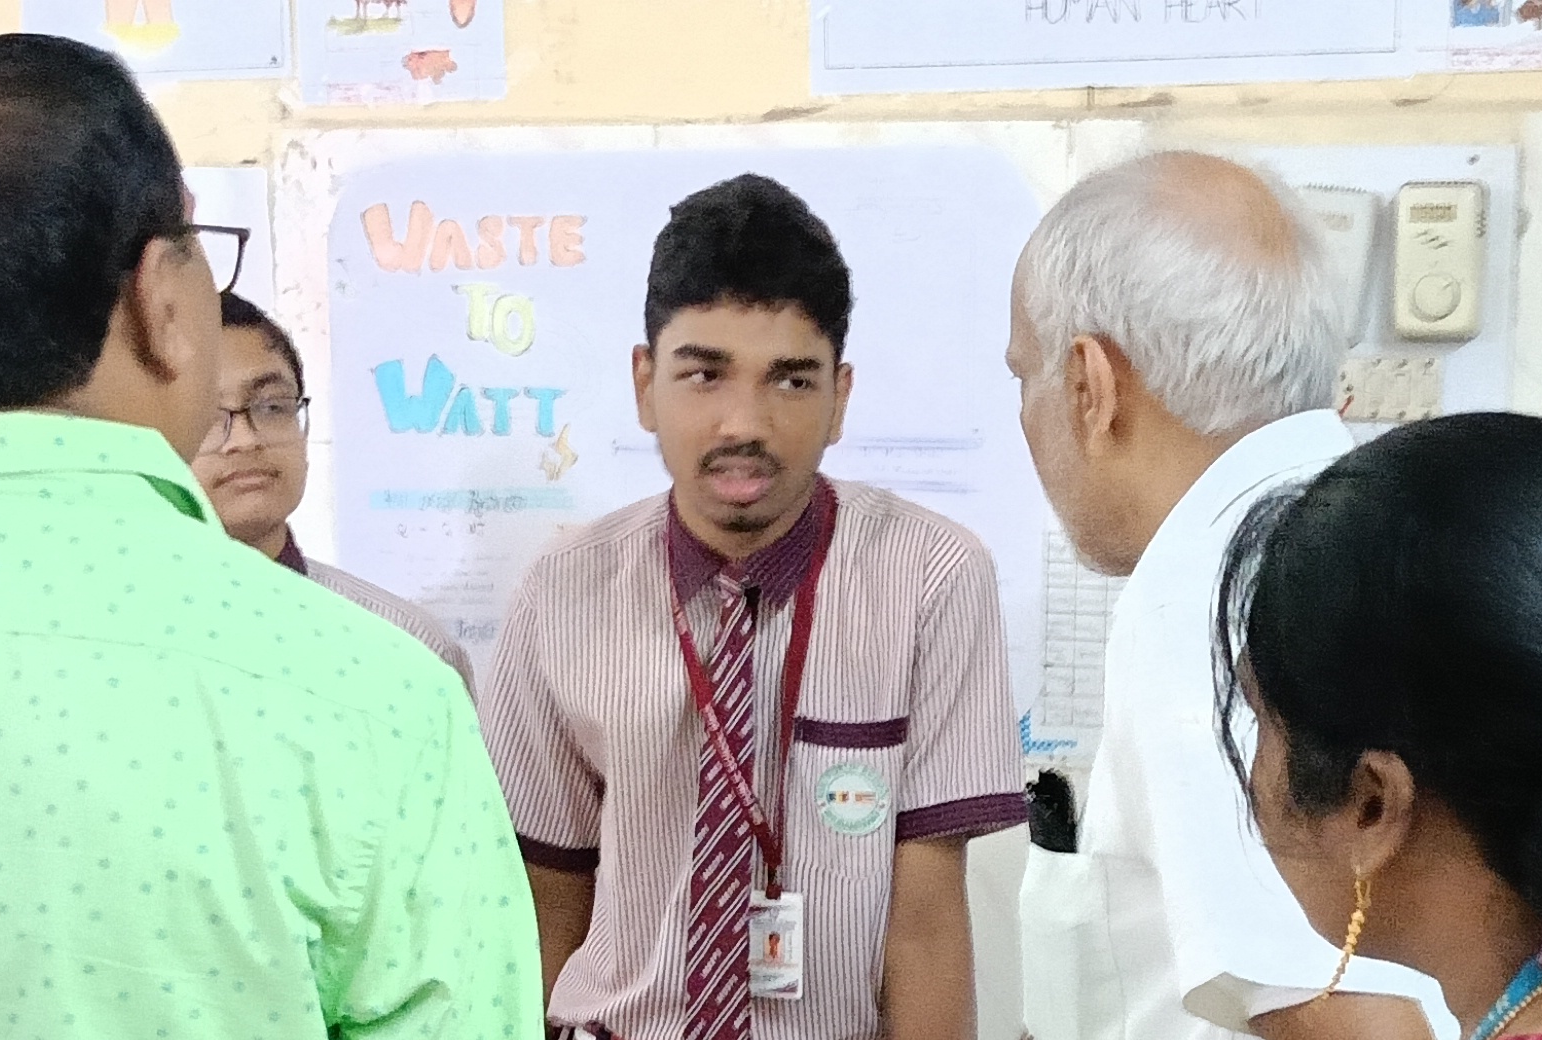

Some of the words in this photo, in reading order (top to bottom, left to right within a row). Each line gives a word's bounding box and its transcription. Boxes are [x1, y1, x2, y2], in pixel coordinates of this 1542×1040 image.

[1025, 0, 1142, 24] HUMAN
[361, 200, 586, 275] WASTE
[452, 282, 537, 357] TO
[370, 354, 568, 439] WATT
